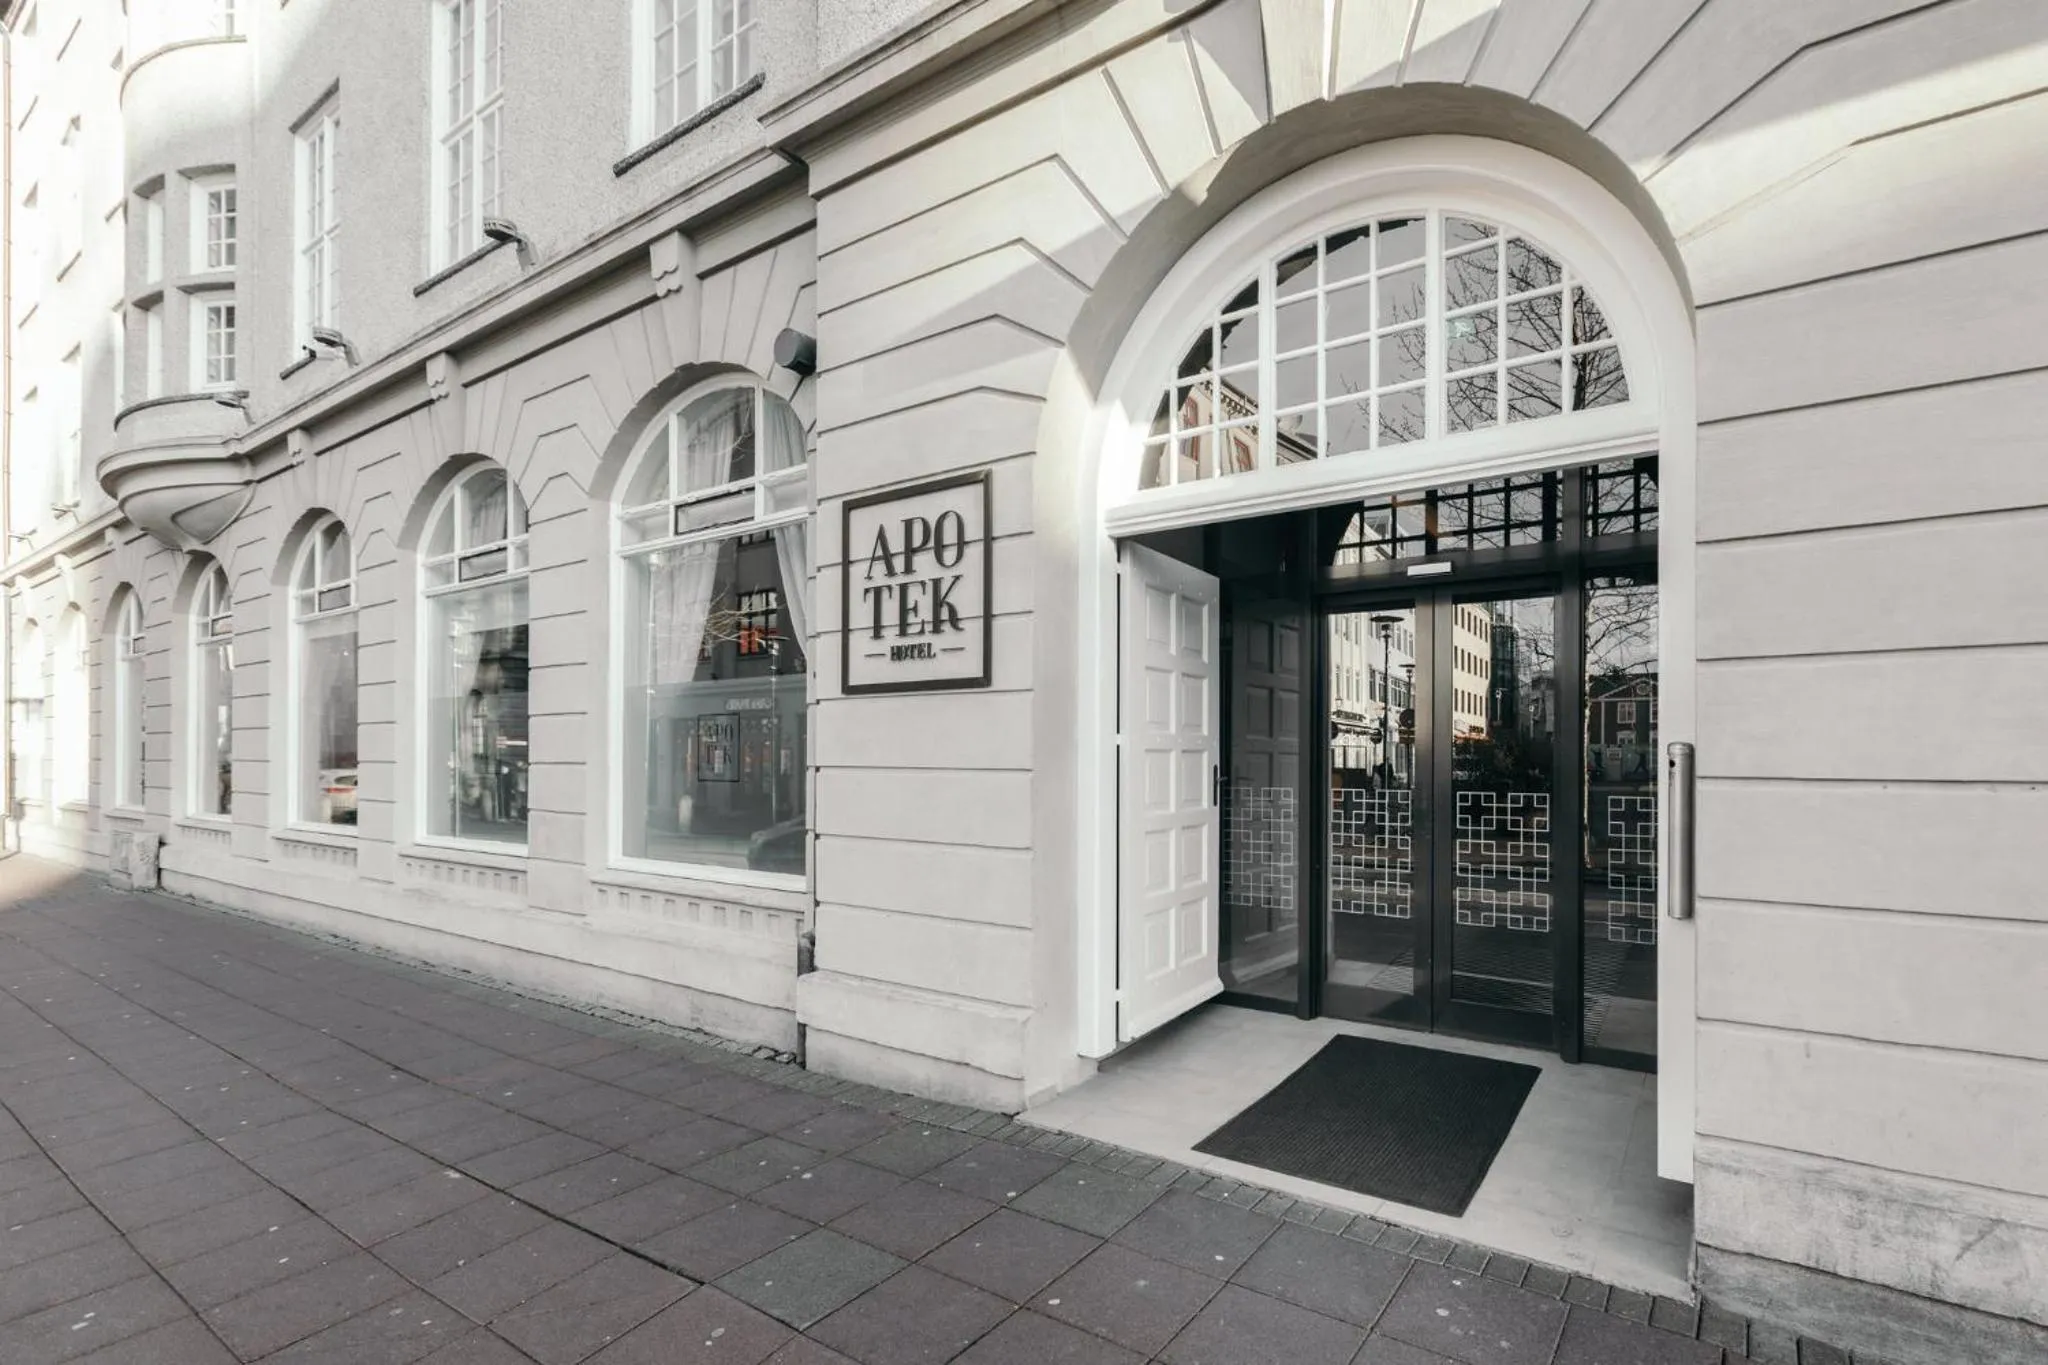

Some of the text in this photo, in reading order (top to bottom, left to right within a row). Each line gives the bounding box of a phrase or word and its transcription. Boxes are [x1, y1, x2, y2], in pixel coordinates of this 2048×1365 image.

[863, 510, 965, 580] APO
[863, 575, 964, 640] TEK
[890, 642, 936, 661] HOTEL
[705, 744, 732, 765] TK
